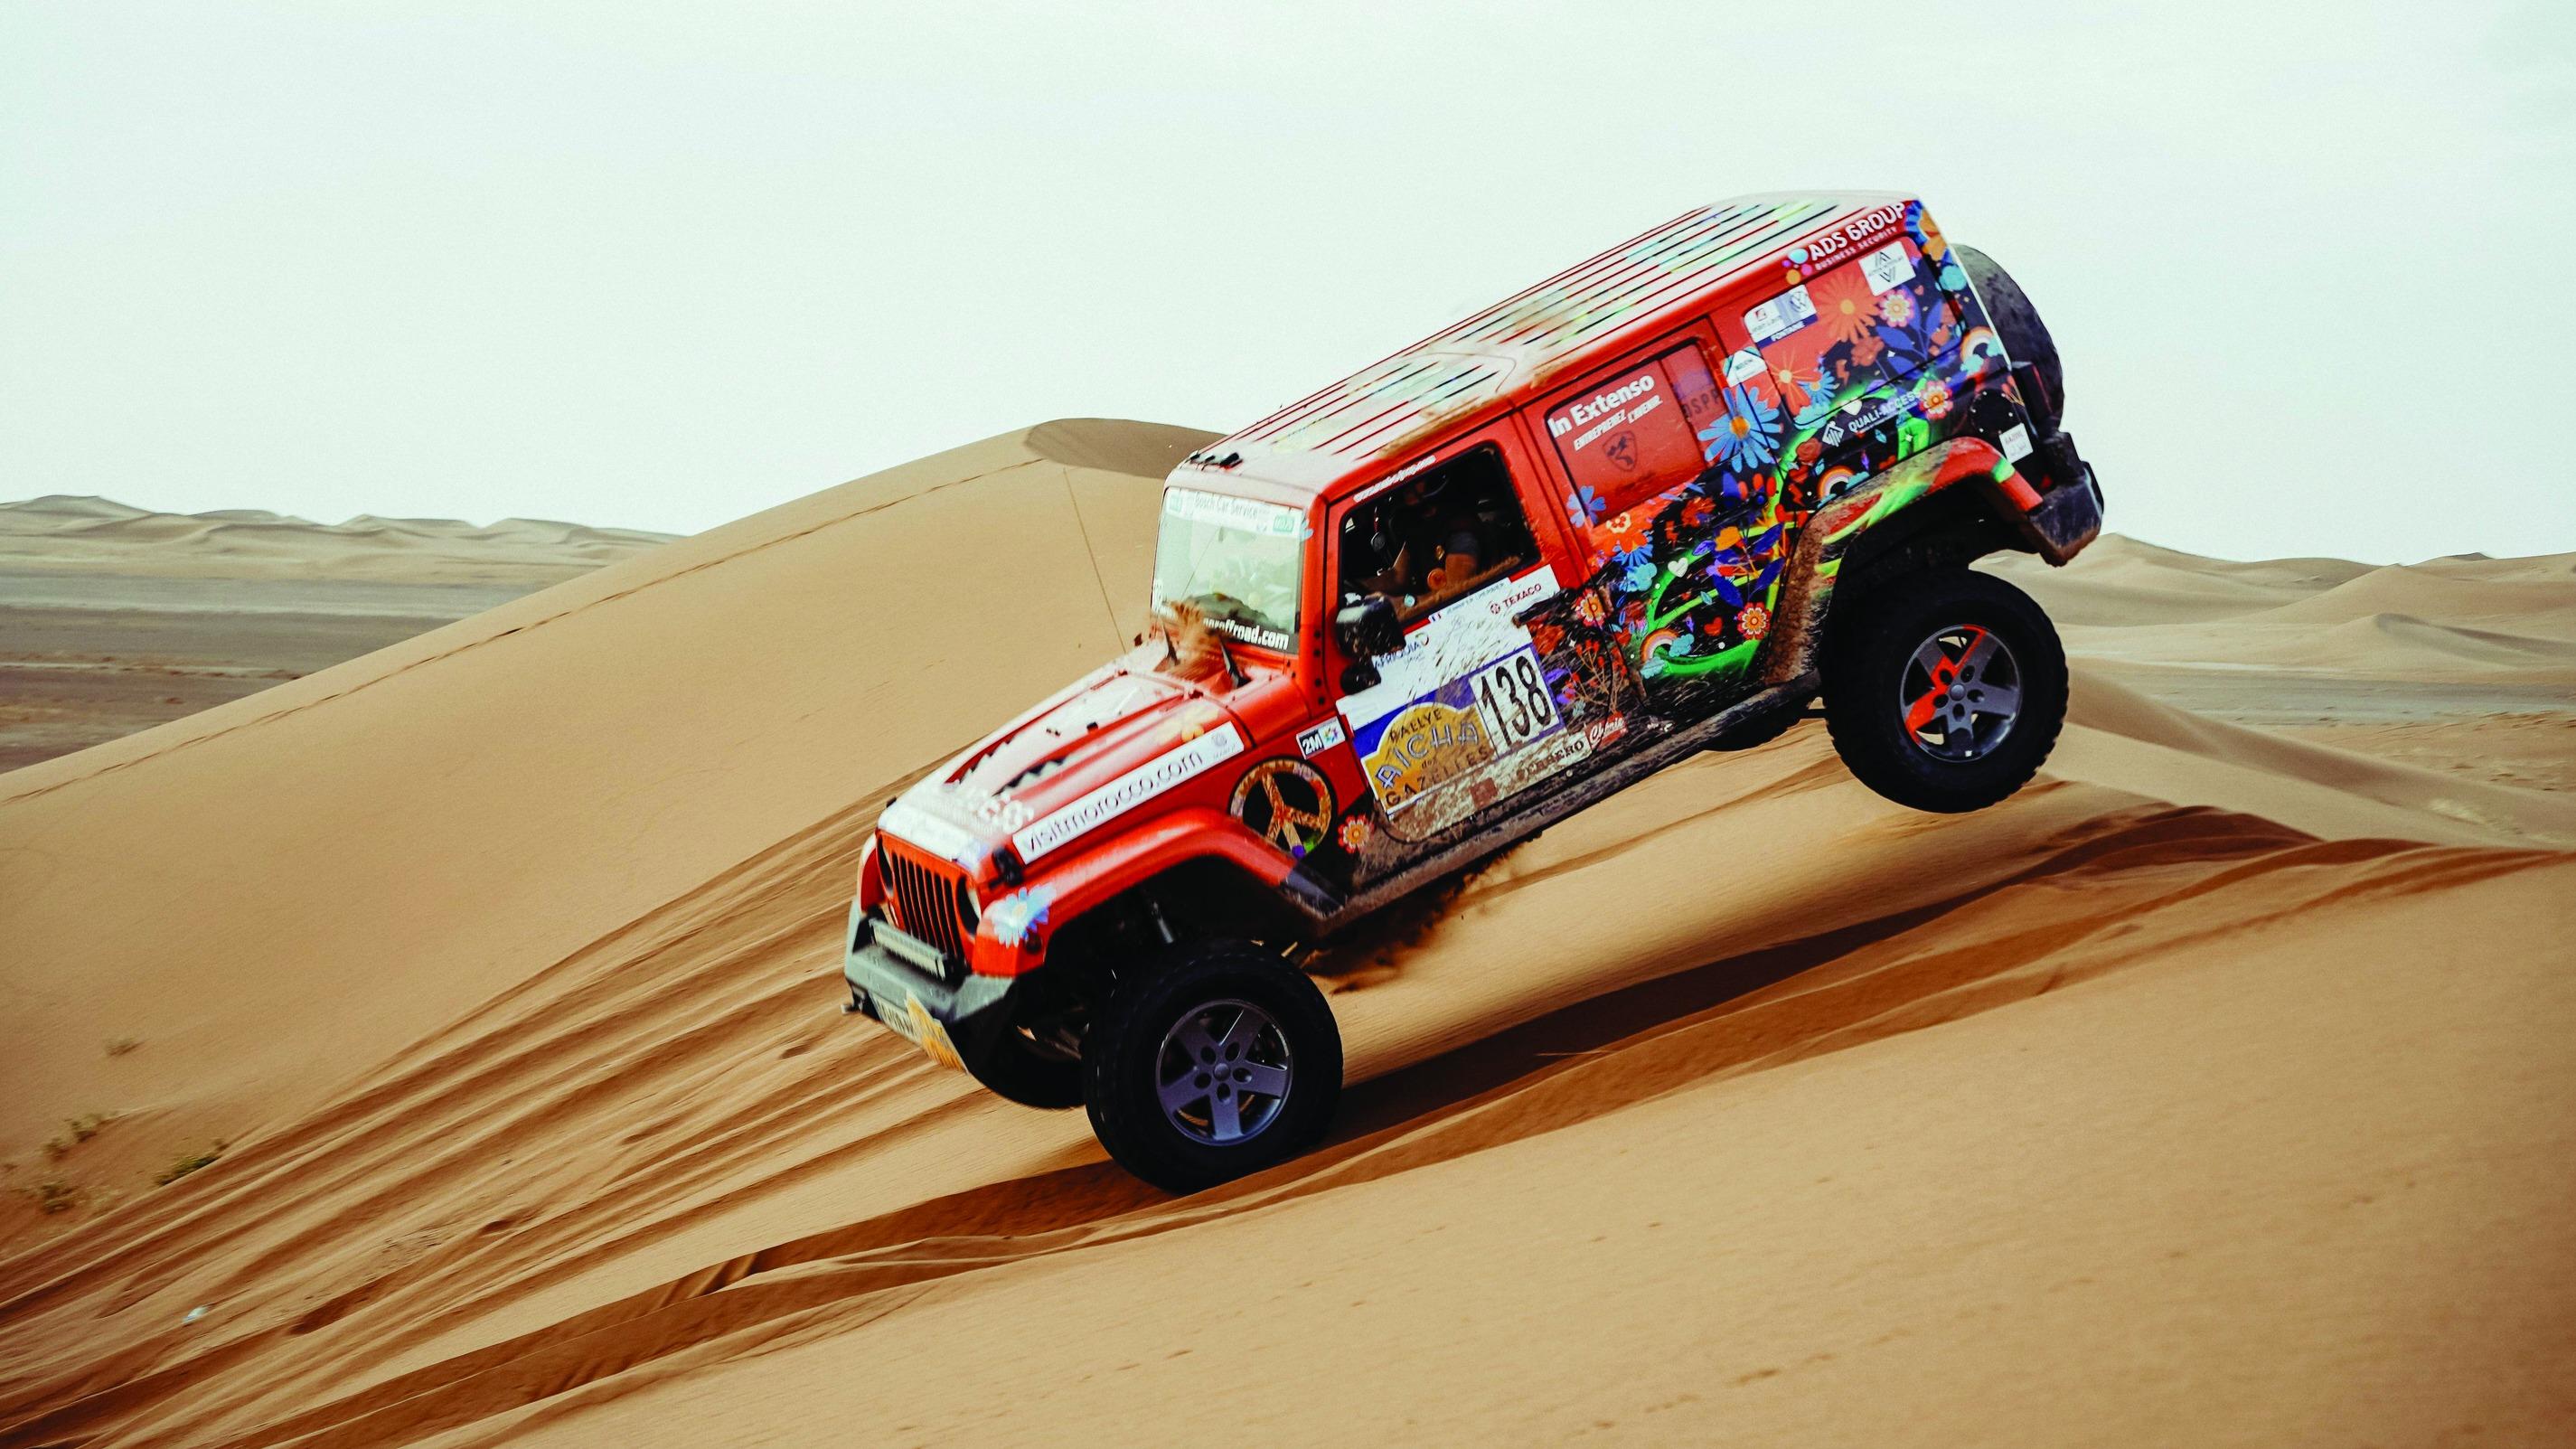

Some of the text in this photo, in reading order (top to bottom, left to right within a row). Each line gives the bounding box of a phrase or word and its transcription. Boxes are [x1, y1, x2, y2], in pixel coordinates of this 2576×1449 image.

[1808, 202, 1905, 261] ADS GROUP
[1547, 375, 1655, 438] In Extenso
[1501, 583, 1542, 608] TEXACO
[1481, 655, 1551, 746] 138
[1302, 733, 1323, 755] 2M
[1022, 750, 1204, 852] visitmorocco.com
